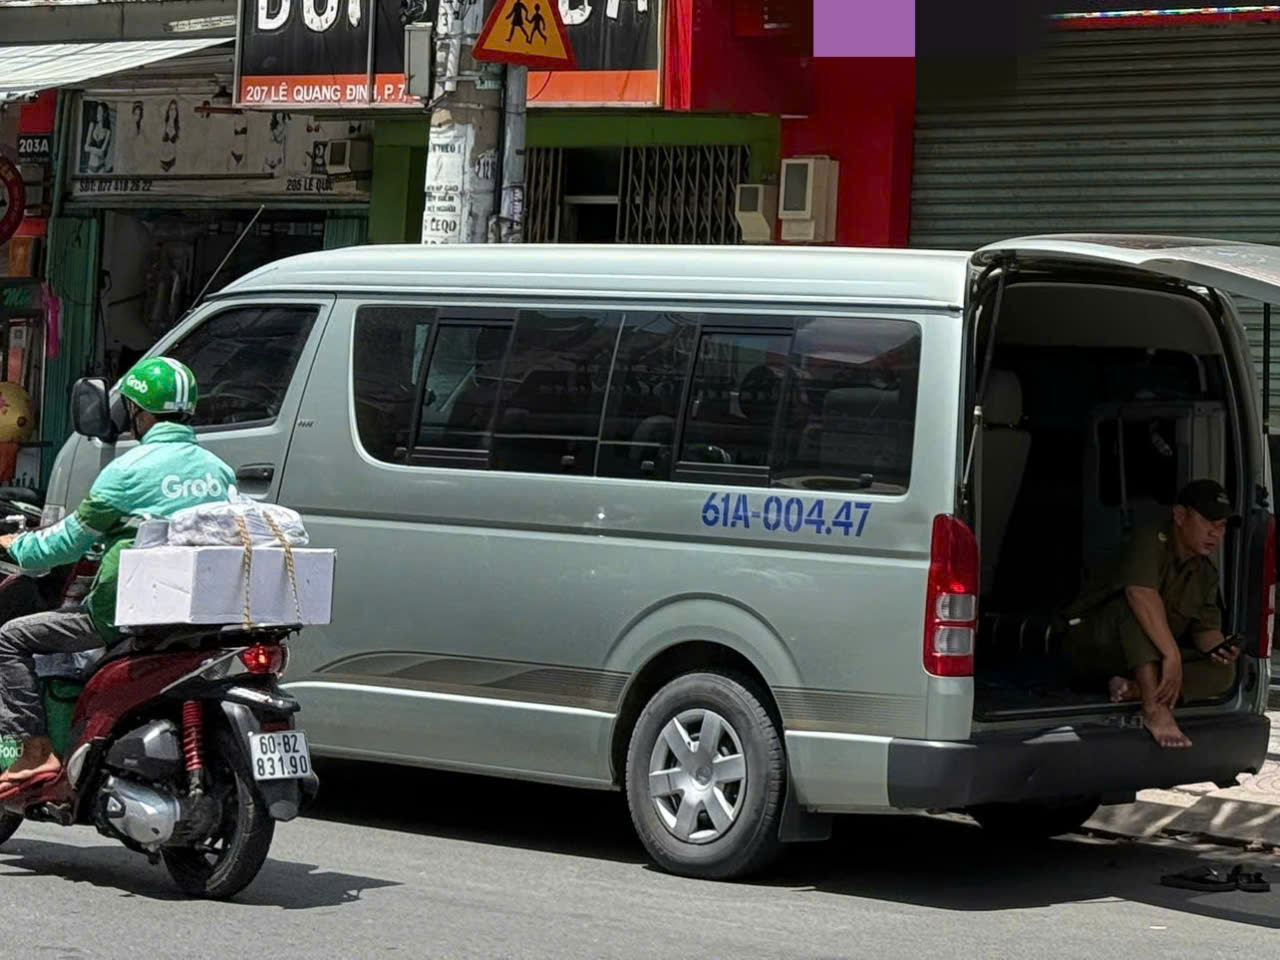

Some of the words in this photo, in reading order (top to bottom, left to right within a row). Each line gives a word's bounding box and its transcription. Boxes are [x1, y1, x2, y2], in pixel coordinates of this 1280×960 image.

[246, 85, 268, 101] 207
[272, 82, 288, 101] LÊ
[293, 85, 341, 102] QUANG
[19, 139, 49, 153] 203A
[126, 374, 148, 393] Grab
[161, 472, 222, 499] Grab
[701, 492, 872, 537] 61A-004.47
[259, 734, 300, 755] 60-B2
[256, 755, 308, 777] 831.90
